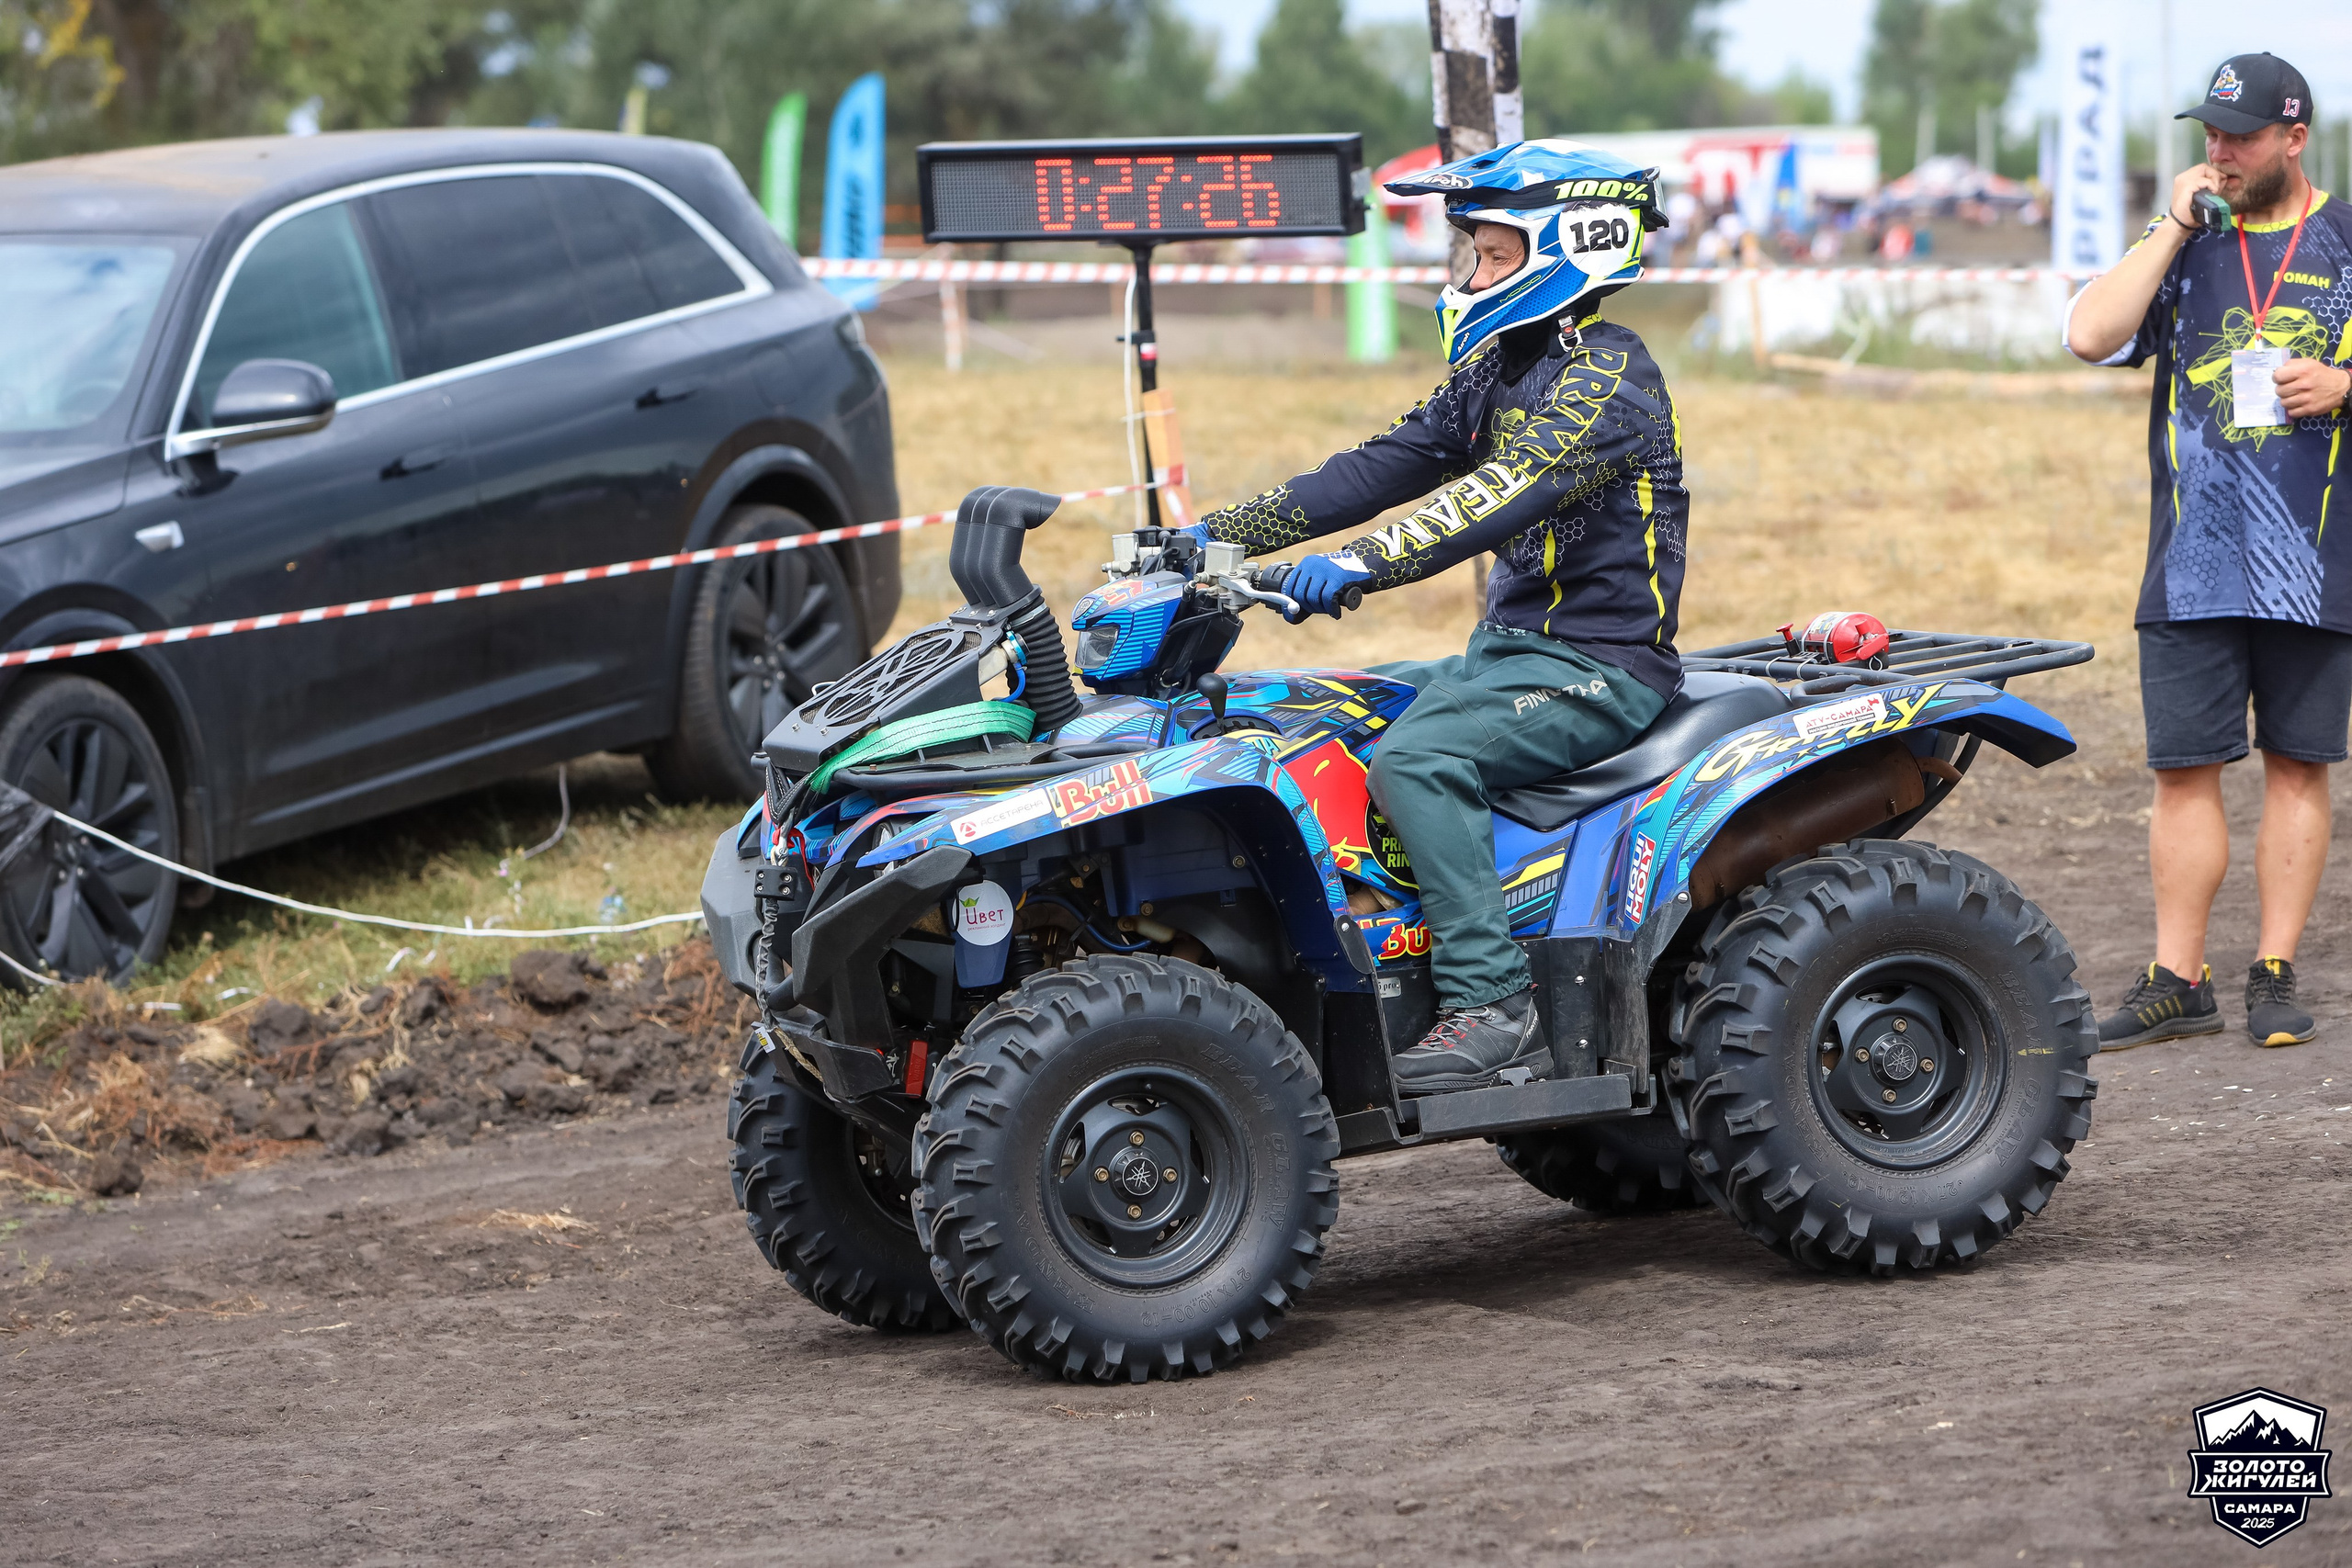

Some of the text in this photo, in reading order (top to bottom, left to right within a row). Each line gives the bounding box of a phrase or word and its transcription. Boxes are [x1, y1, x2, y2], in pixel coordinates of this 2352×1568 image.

[2283, 97, 2301, 118] 13
[1035, 154, 1281, 231] 0:27:26
[1554, 179, 1649, 201] 100%
[1569, 218, 1630, 254] 120
[1366, 461, 1532, 562] TEAM
[1053, 760, 1154, 829] Bull
[1382, 837, 1405, 852] PRI
[1624, 837, 1645, 917] LIQUI
[1632, 839, 1654, 921] MOLY
[1200, 1043, 1276, 1114] BEAR
[1017, 1210, 1096, 1314] KENDA
